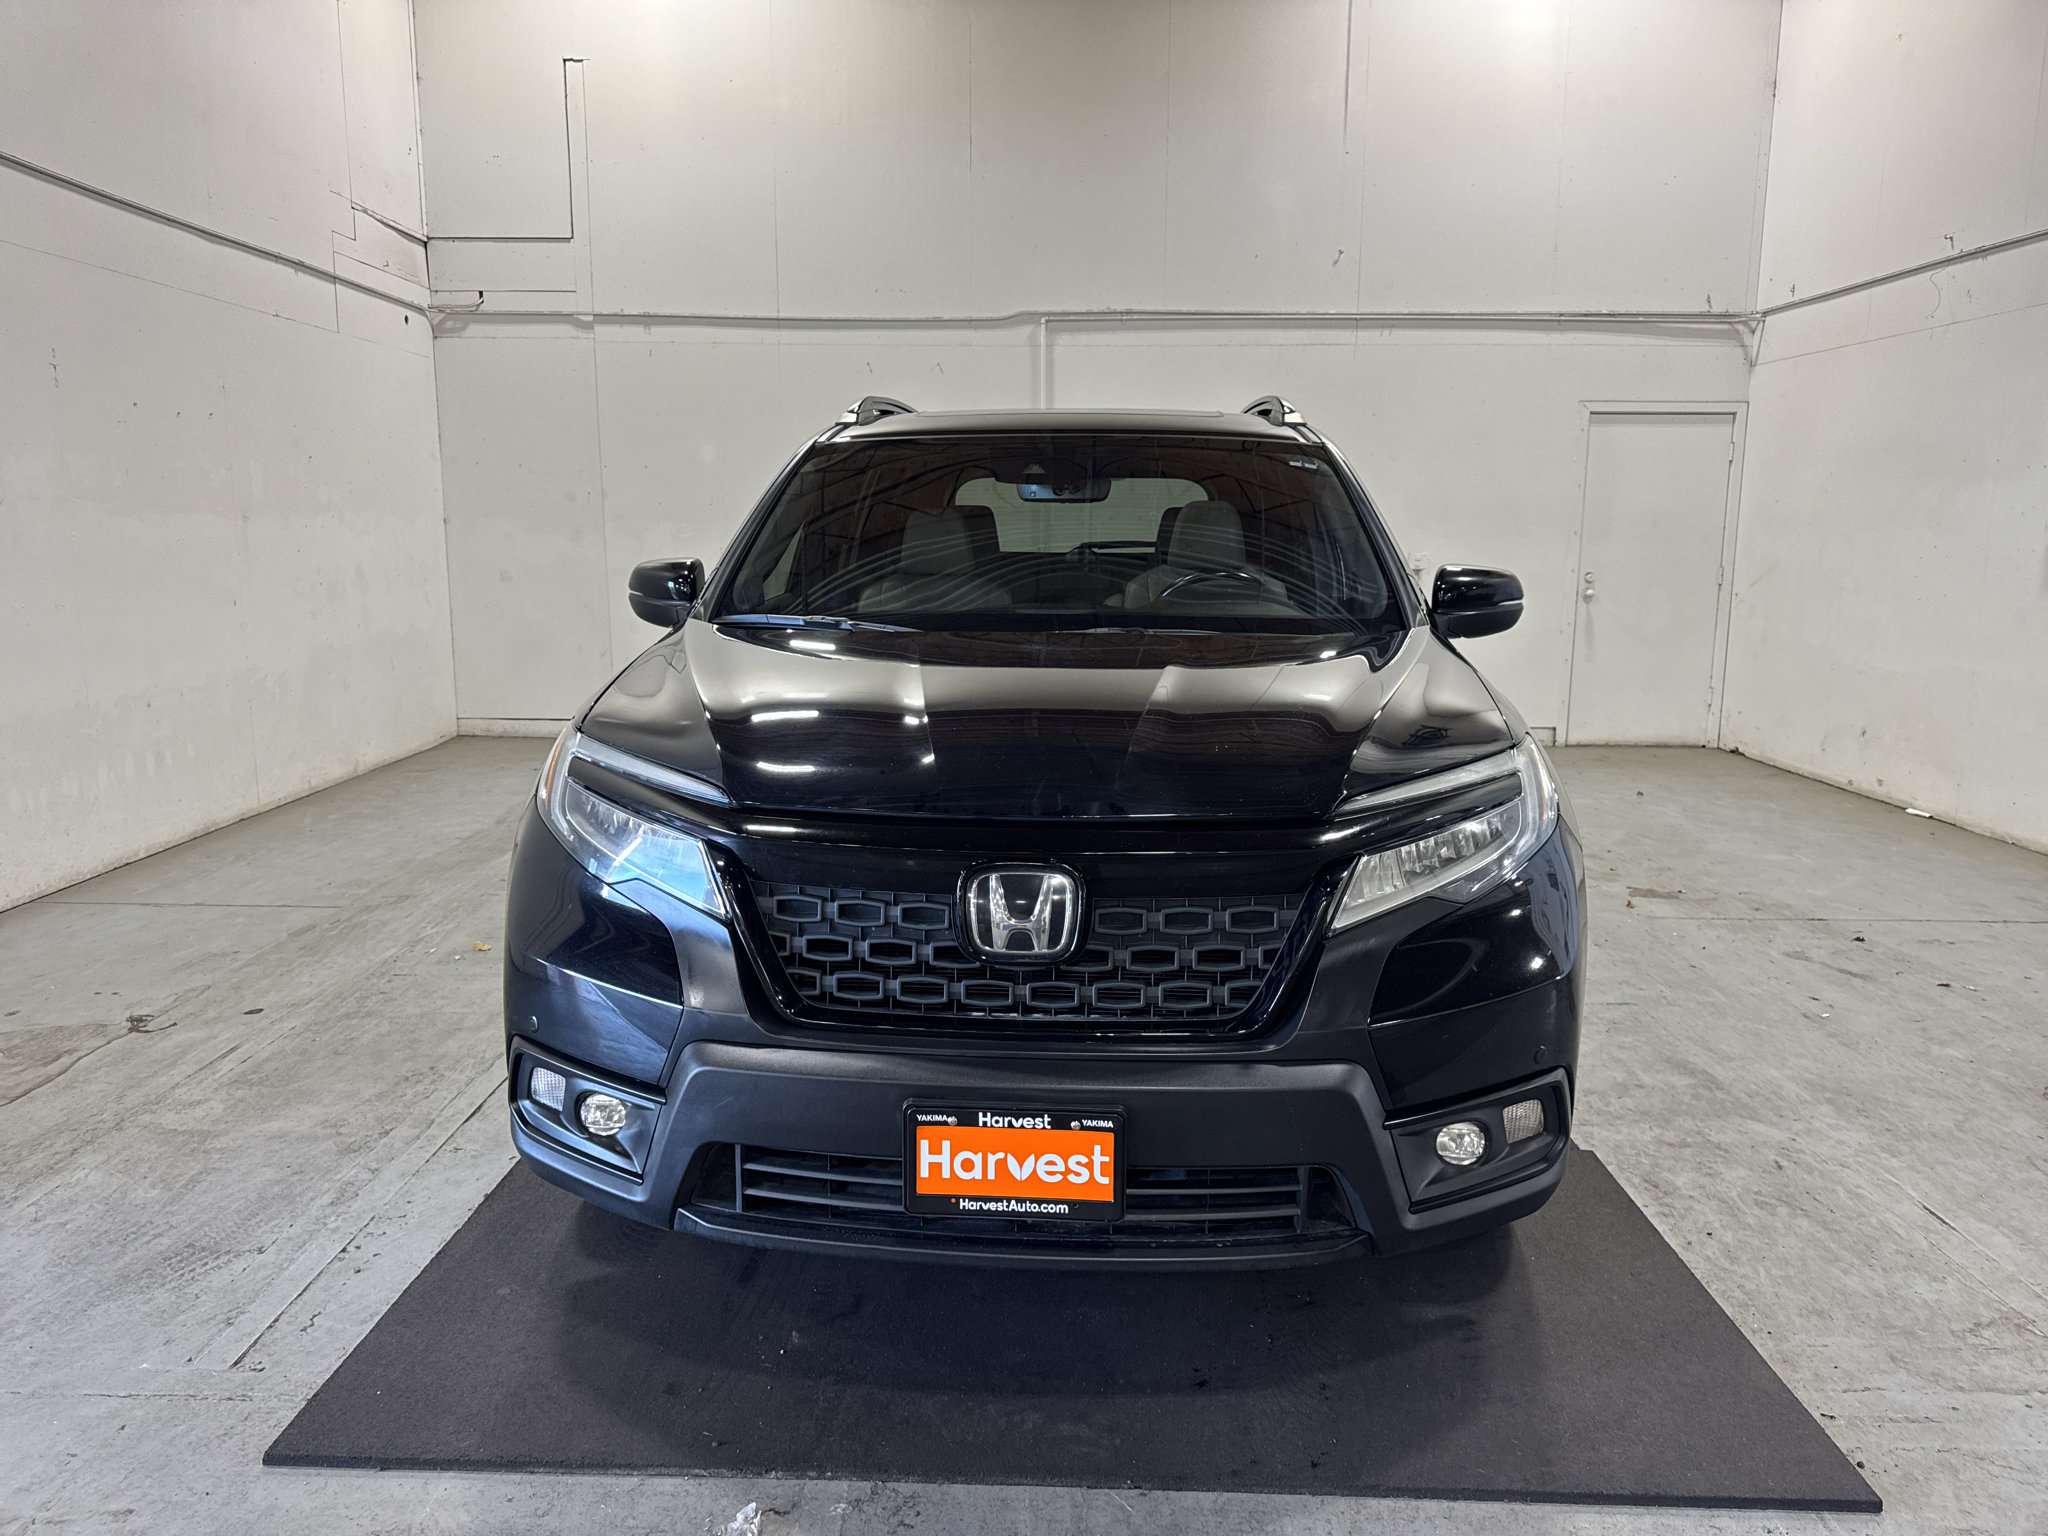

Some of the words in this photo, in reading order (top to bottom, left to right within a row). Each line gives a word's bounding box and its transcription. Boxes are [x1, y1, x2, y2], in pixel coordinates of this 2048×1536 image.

[917, 1114, 948, 1122] YAKIMA
[978, 1112, 1052, 1129] Harvest
[1081, 1119, 1114, 1128] YAKIMA
[920, 1139, 1110, 1184] Harvest
[959, 1198, 1069, 1214] HarvestAuto.com
